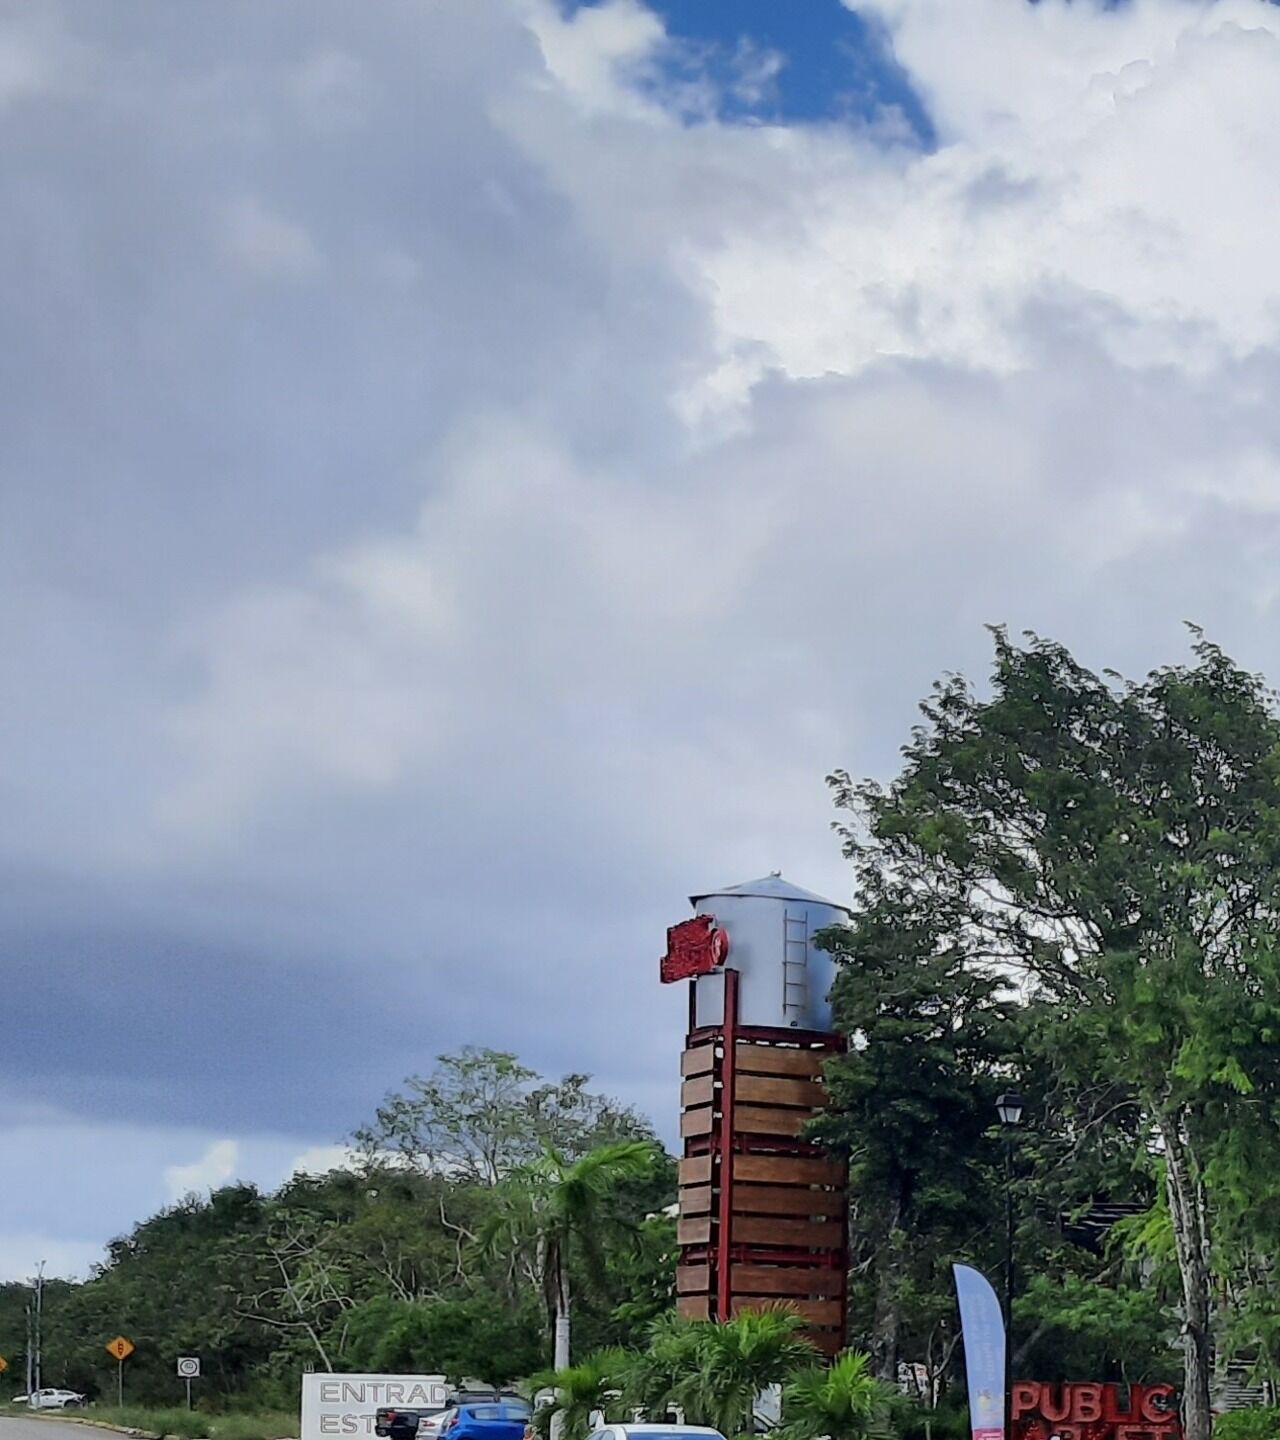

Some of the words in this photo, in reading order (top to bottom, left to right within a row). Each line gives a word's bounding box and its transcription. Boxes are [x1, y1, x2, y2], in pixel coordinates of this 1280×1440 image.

[320, 1382, 451, 1404] ENTRAD
[1010, 1381, 1177, 1422] PUBLIC
[320, 1413, 377, 1434] EST
